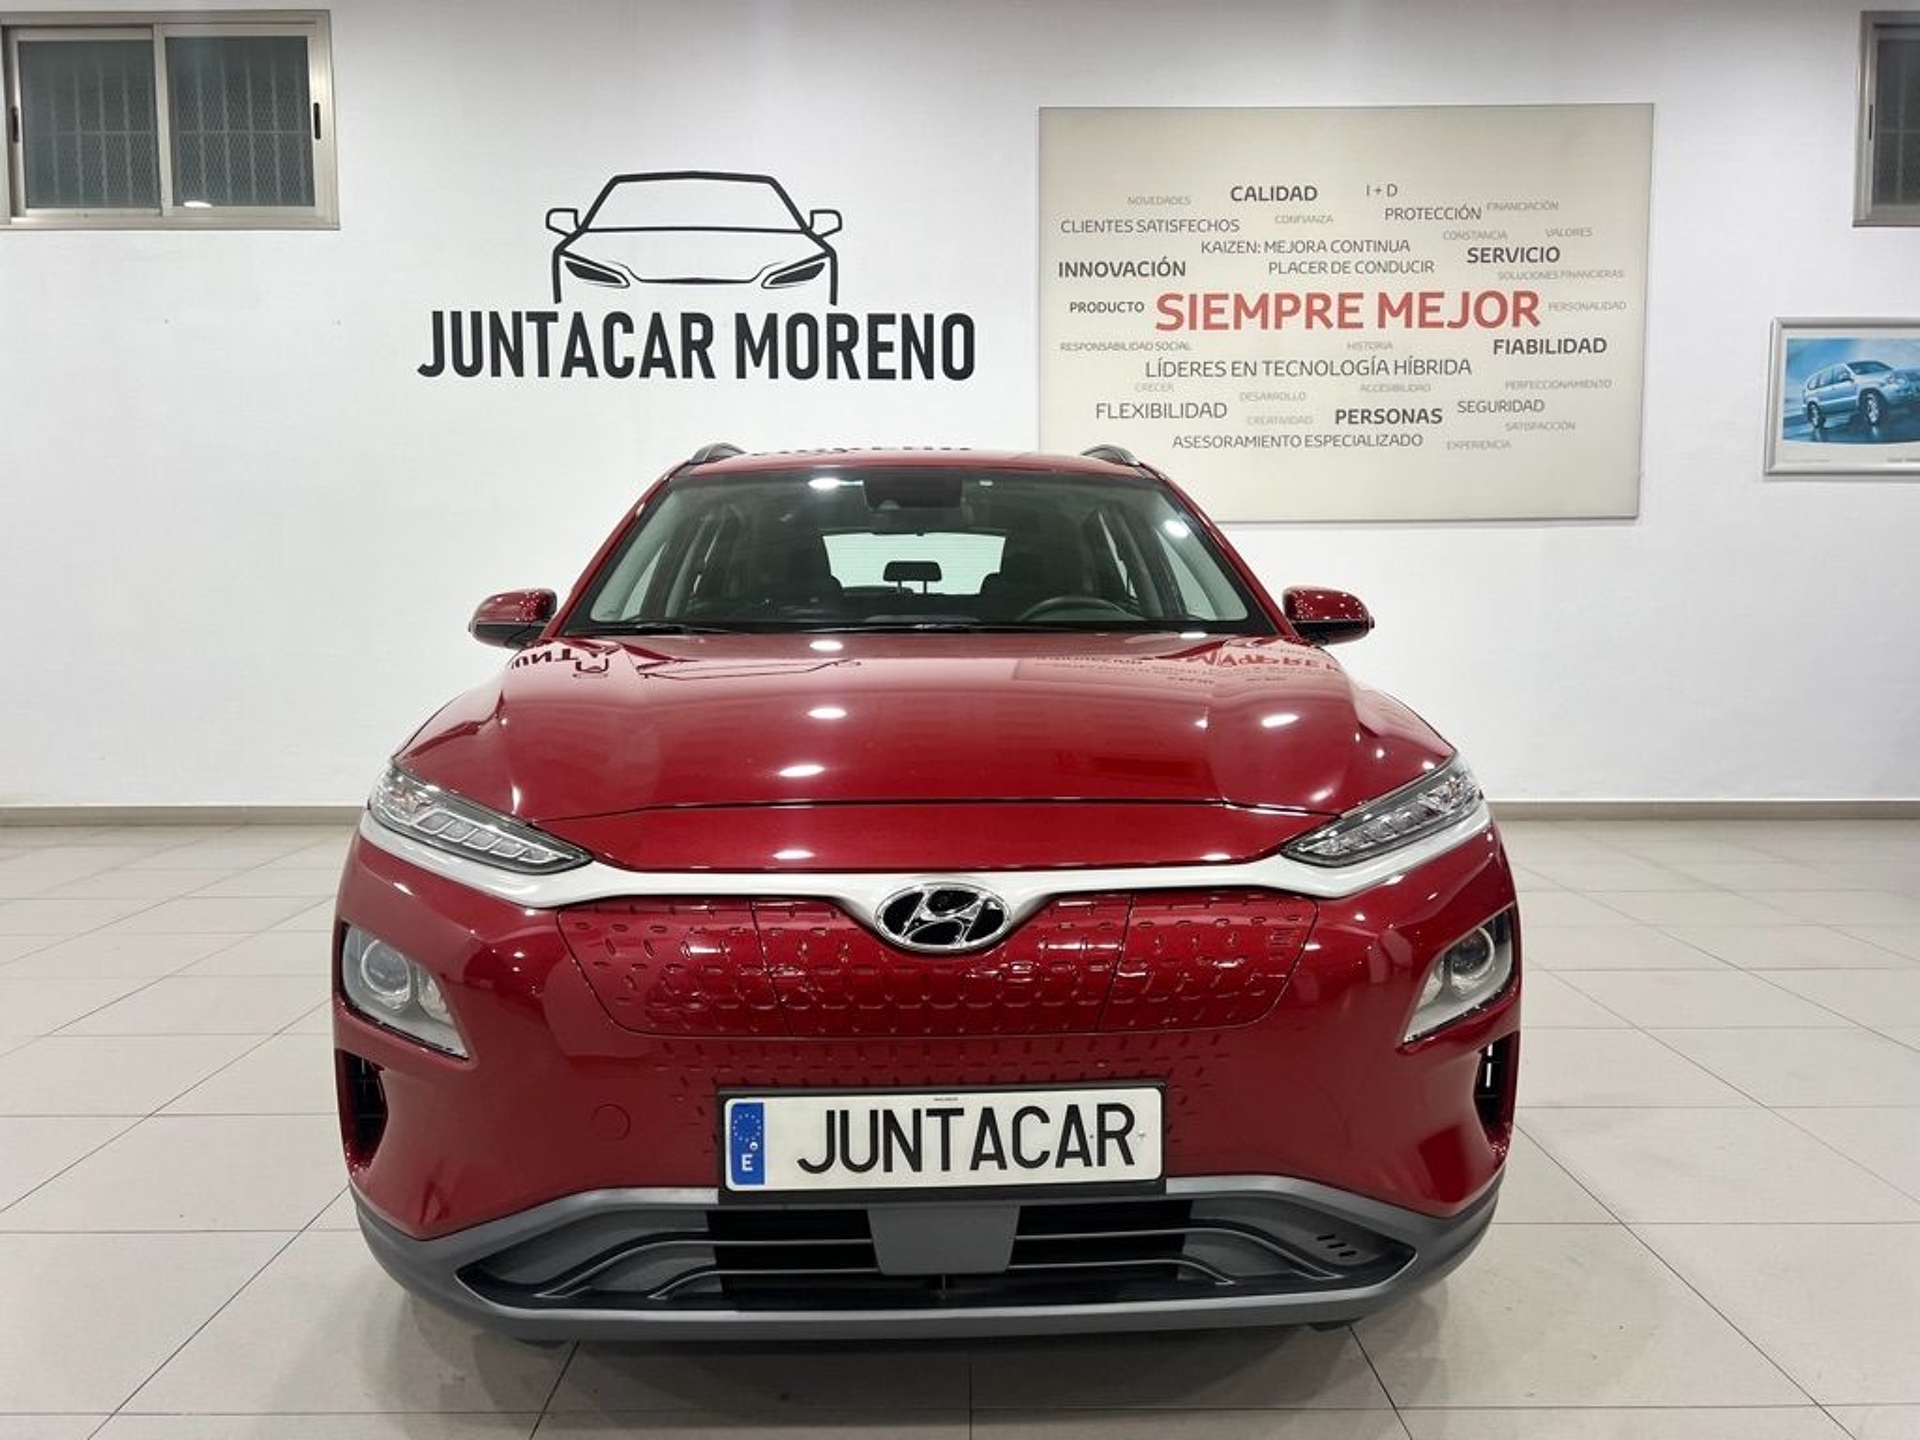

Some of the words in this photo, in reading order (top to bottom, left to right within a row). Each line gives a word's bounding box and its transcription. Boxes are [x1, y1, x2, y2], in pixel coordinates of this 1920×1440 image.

[1230, 185, 1318, 202] CALIDAD
[1387, 184, 1398, 197] D
[1127, 195, 1191, 206] NOVEDADES
[1274, 214, 1334, 225] CONFIANZA
[1384, 205, 1482, 220] PROTECCIÓN
[1060, 219, 1134, 233] CLIENTES
[1136, 219, 1240, 233] SATISFECHOS
[1545, 227, 1593, 238] VALORES
[1443, 230, 1507, 241] CONSTANCIA
[1200, 240, 1261, 254] KAIZEN:
[1264, 239, 1327, 254] MEJORA
[1330, 239, 1411, 253] CONTINUA
[1466, 246, 1561, 263] SERVICIO
[1058, 256, 1187, 278] INNOVACIÓN
[1268, 261, 1328, 275] PLACER
[1331, 261, 1351, 275] DE
[1355, 260, 1435, 274] CONDUCIR
[1069, 301, 1145, 314] PRODUCTO
[1155, 292, 1364, 331] SIEMPRE
[1377, 290, 1541, 329] MEJOR
[1548, 301, 1627, 312] PERSONALIDAD
[417, 311, 715, 379] JUNTACAR
[735, 313, 976, 381] MORENO
[1060, 342, 1154, 351] RESPONSABILIDAD
[1155, 341, 1192, 351] SOCIAL
[1347, 341, 1393, 350] HISTORIA
[1493, 337, 1608, 355] FIABILIDAD
[1145, 357, 1227, 378] LÍDERES
[1231, 360, 1258, 377] EN
[1261, 355, 1390, 377] TECNOLOGÍA
[1394, 355, 1472, 376] HÍBRIDA
[1134, 382, 1174, 393] CRECER
[1360, 384, 1431, 393] ACCESIBILIDAD
[1505, 379, 1612, 391] PERFECCIONAMIENTO
[1239, 391, 1306, 402] DESARROLLO
[1096, 402, 1228, 420] FLEXIBILIDAD
[1457, 399, 1545, 414] SEGURIDAD
[1335, 408, 1443, 425] PERSONAS
[1172, 435, 1301, 449] ASESORAMIENTO
[1305, 433, 1424, 448] ESPECIALIZADO
[1446, 440, 1512, 450] EXPERIENCIA
[797, 1103, 1137, 1174] JUNTACAR
[741, 1154, 753, 1171] E
